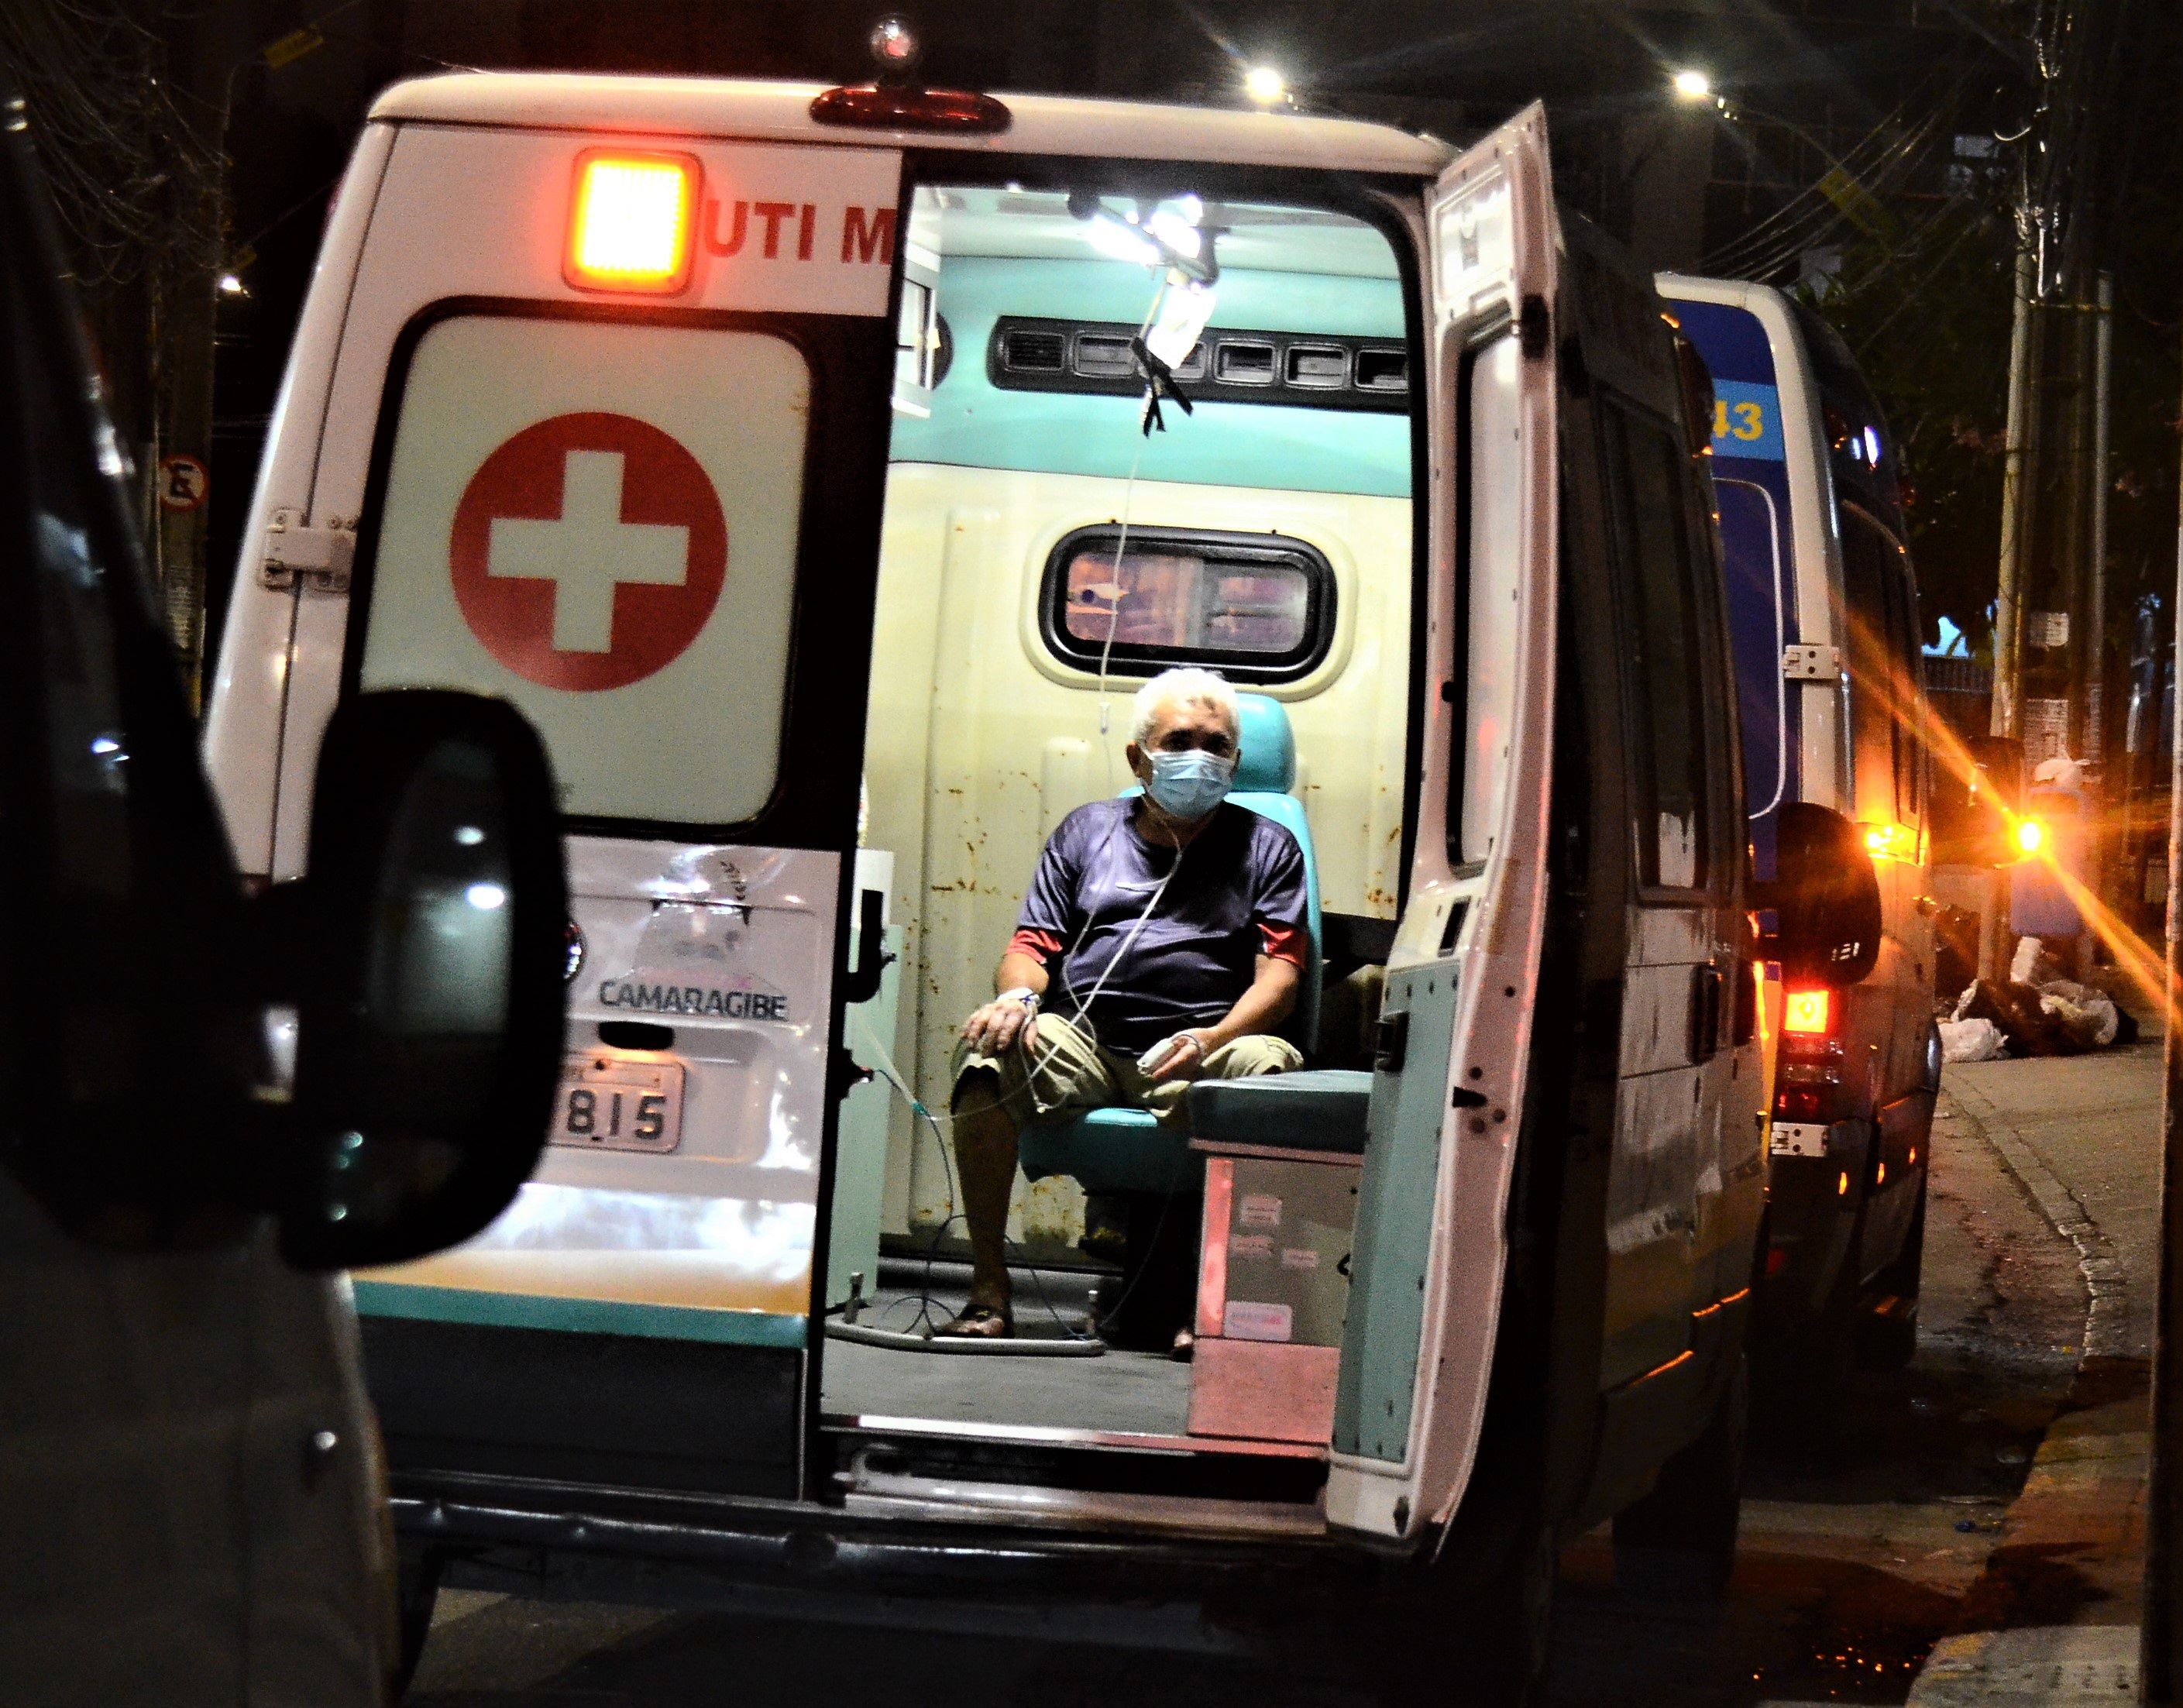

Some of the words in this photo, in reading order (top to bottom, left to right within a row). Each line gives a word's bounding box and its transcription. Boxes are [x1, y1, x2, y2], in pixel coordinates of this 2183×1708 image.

[703, 200, 816, 260] UTI
[841, 206, 896, 265] M
[600, 980, 789, 1022] CAMARAGIBE
[567, 1089, 667, 1140] 815
